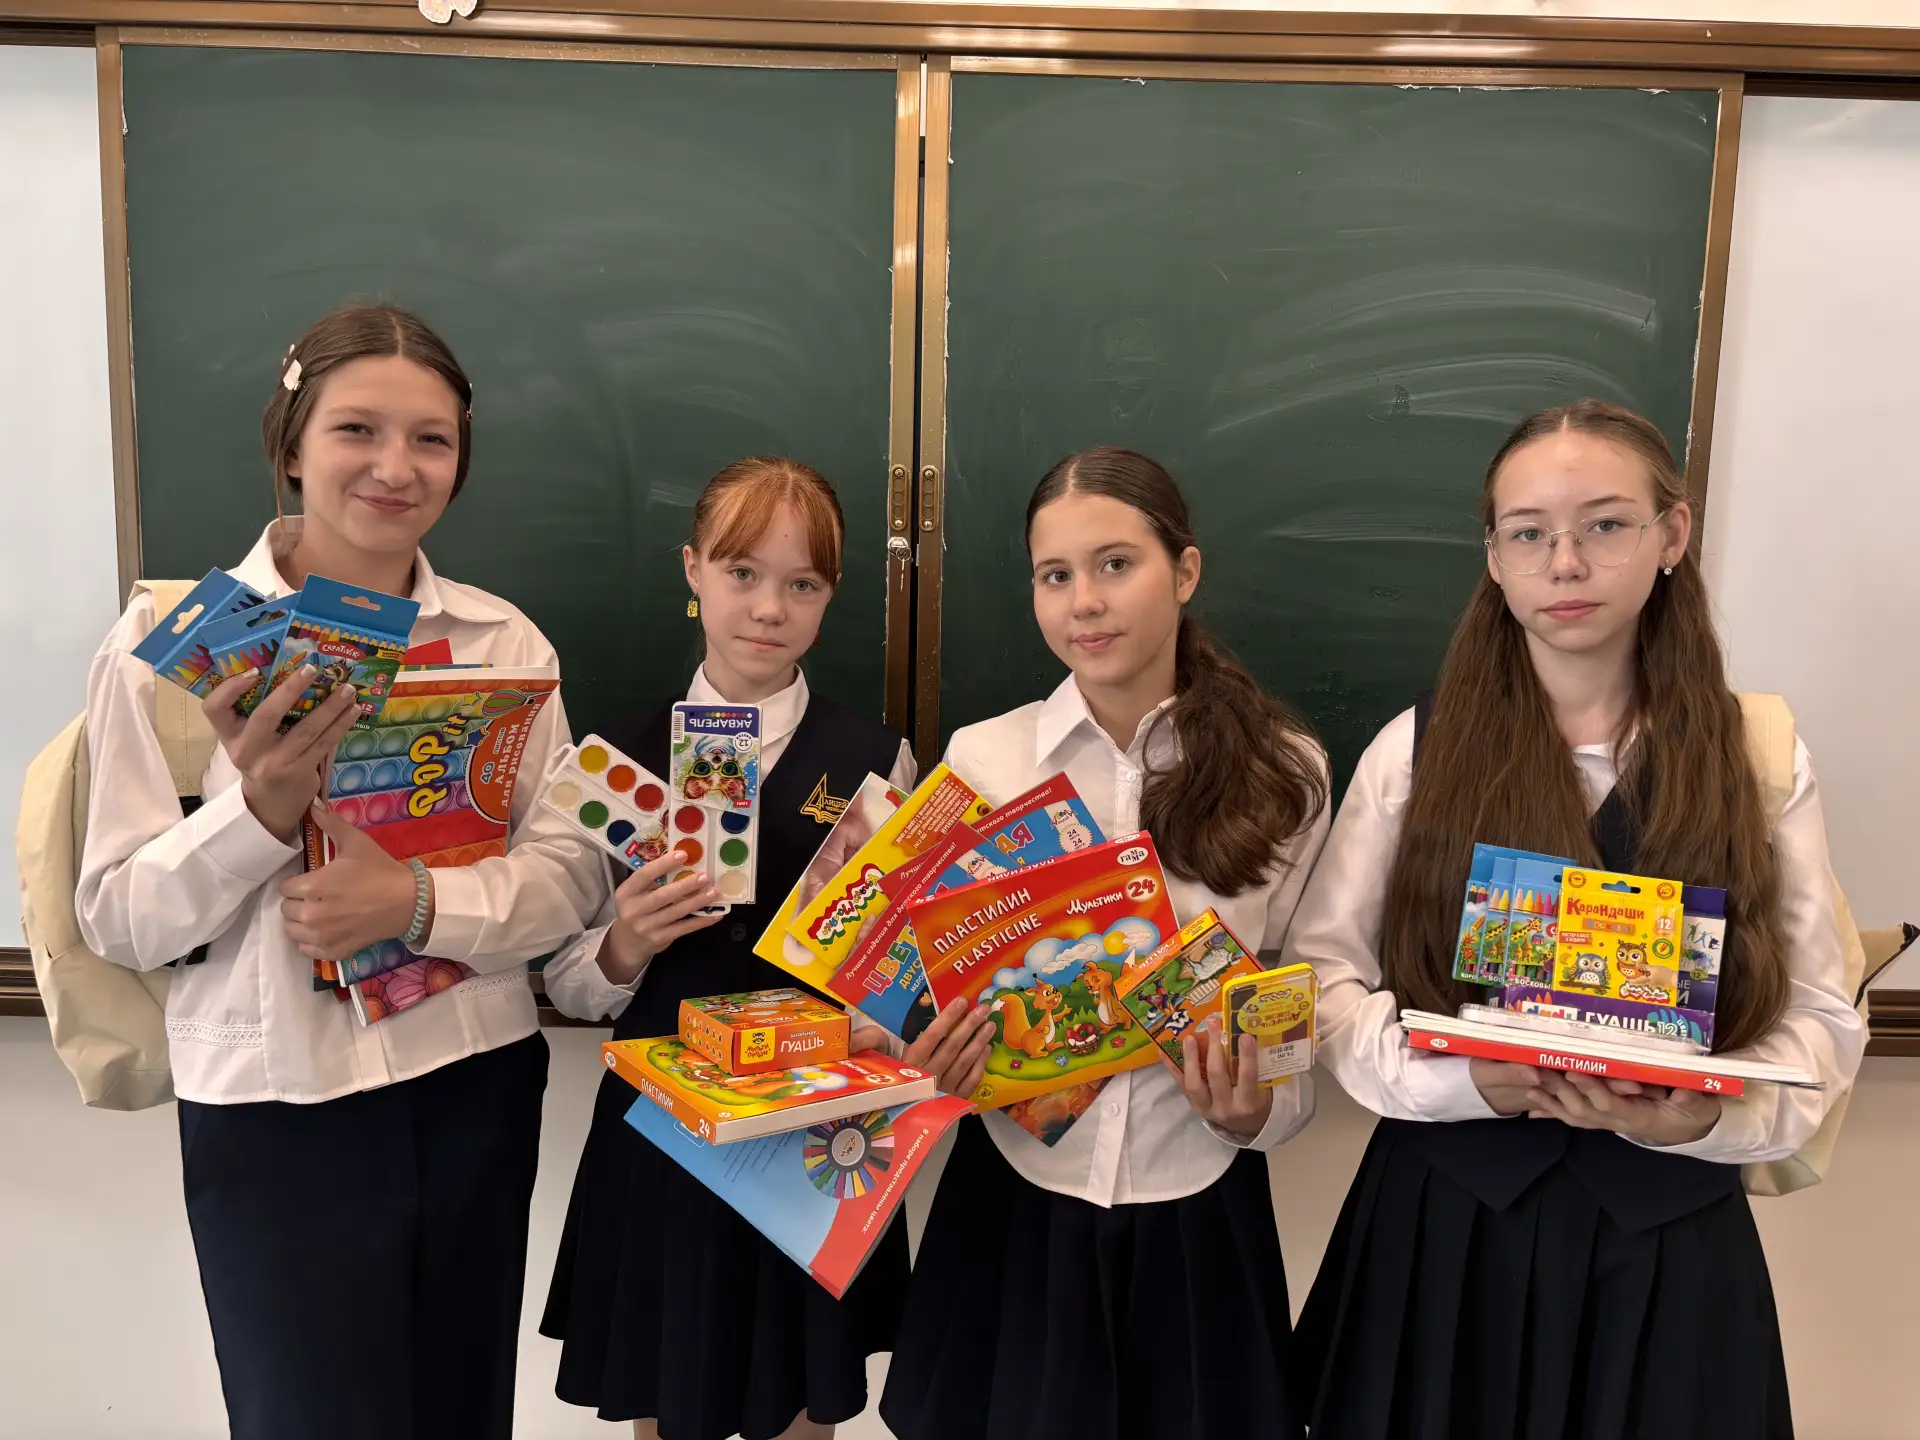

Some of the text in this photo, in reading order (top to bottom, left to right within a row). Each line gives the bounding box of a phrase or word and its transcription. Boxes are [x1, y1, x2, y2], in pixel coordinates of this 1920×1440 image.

[442, 712, 468, 736] it
[689, 718, 753, 729] АКВАРЕЛЬ
[494, 723, 520, 785] АЛЬБОМ
[739, 738, 749, 747] 12
[480, 761, 495, 784] 40
[1005, 787, 1052, 818] творчества!
[1066, 829, 1077, 838] 24
[1072, 838, 1083, 847] 24
[987, 857, 1055, 881] ПЛАСТИЛИН
[1065, 878, 1157, 916] Мультики 24
[845, 841, 957, 980] Лучшие изделия для детского творчества!
[933, 887, 1032, 955] ПЛАСТИЛИН
[1659, 918, 1671, 929] 12
[952, 913, 1043, 975] PLASTICINE
[1515, 978, 1554, 990] ВОСКОВЫ
[780, 1035, 825, 1053] ГУАШЬ
[1539, 1053, 1722, 1091] ПЛАСТИЛИН 24
[641, 1078, 674, 1111] ПЛАСТИЛИН
[699, 1118, 710, 1138] 24
[906, 1133, 924, 1160] наборе
[876, 1159, 908, 1211] представлены
